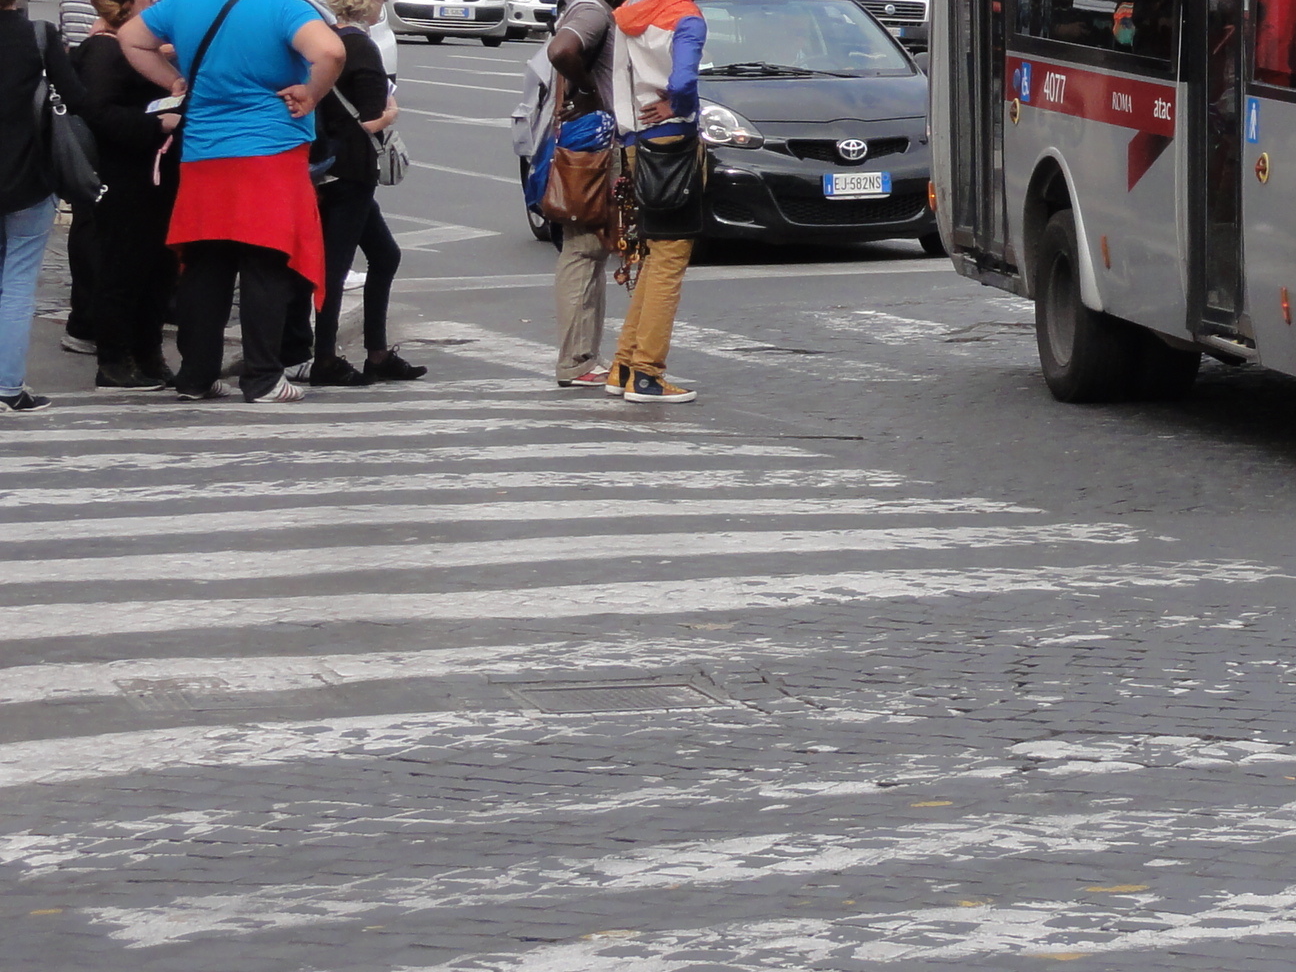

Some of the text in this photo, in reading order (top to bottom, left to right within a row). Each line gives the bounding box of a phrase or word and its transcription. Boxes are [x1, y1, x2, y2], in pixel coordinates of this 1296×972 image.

[1043, 71, 1066, 104] 4077
[1111, 91, 1133, 113] ROMA
[1153, 97, 1172, 120] atac
